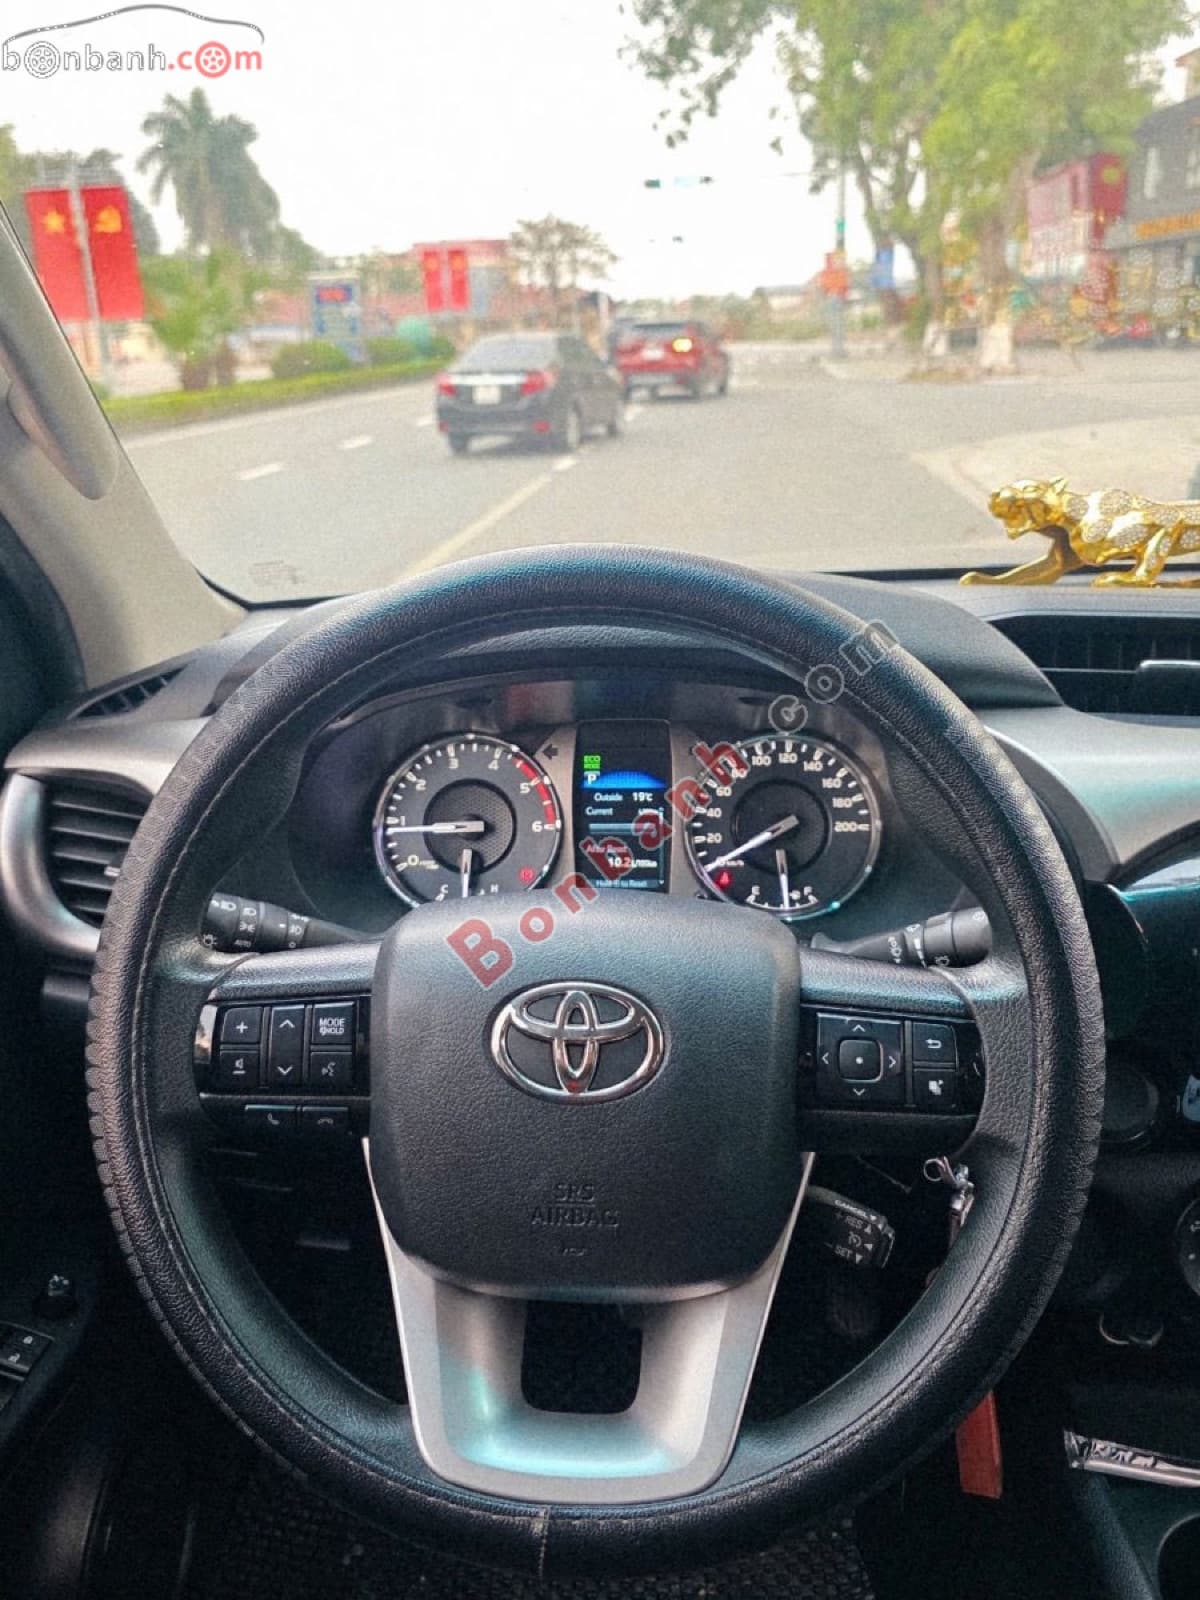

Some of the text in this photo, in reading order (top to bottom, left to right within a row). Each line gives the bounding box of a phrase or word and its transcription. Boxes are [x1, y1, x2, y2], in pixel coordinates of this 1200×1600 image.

[449, 758, 459, 769] 3
[752, 755, 771, 766] 100
[779, 753, 798, 764] 120
[488, 759, 499, 770] 4
[804, 760, 823, 771] 140
[416, 779, 427, 790] 2
[588, 774, 597, 785] P
[822, 778, 842, 788] 160
[519, 782, 531, 793] 5
[716, 786, 732, 797] 60
[832, 797, 852, 808] 180
[707, 807, 722, 818] 40
[532, 820, 543, 832] 6
[834, 821, 857, 832] 200
[706, 833, 722, 844] 20
[407, 854, 420, 866] 0
[441, 884, 449, 893] C
[319, 1018, 345, 1027] MODE
